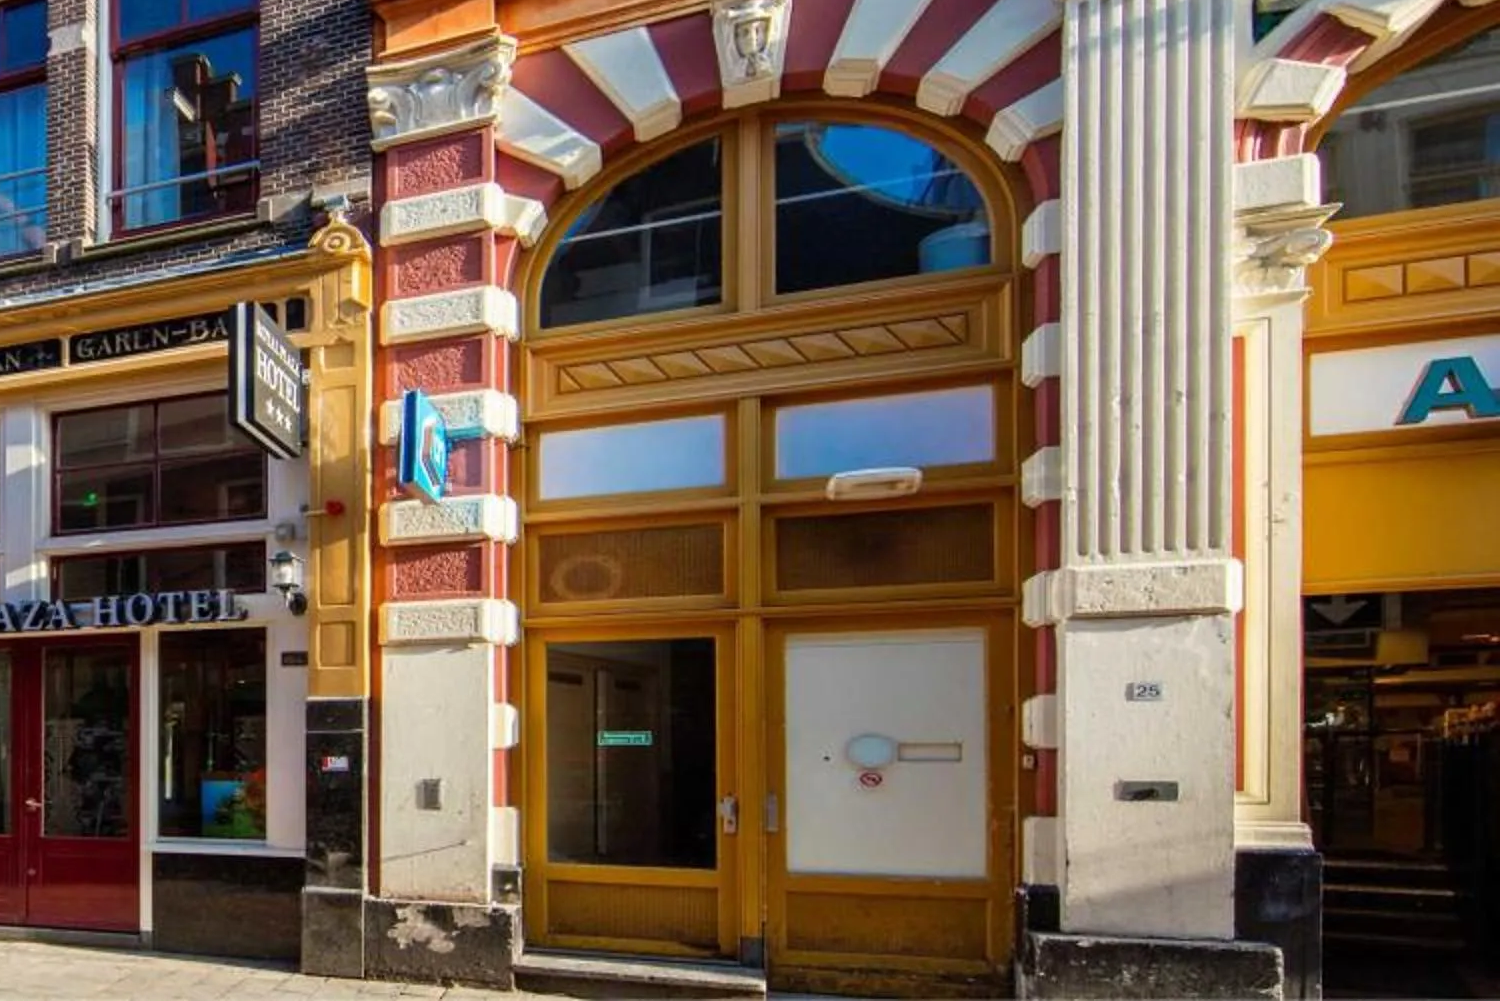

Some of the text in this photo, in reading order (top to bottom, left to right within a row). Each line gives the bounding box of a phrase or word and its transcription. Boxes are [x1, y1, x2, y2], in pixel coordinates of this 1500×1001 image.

[75, 316, 229, 360] GAREN-BA
[256, 346, 301, 415] HOTEL
[91, 587, 244, 627] HOTEL
[1136, 684, 1161, 698] 25
